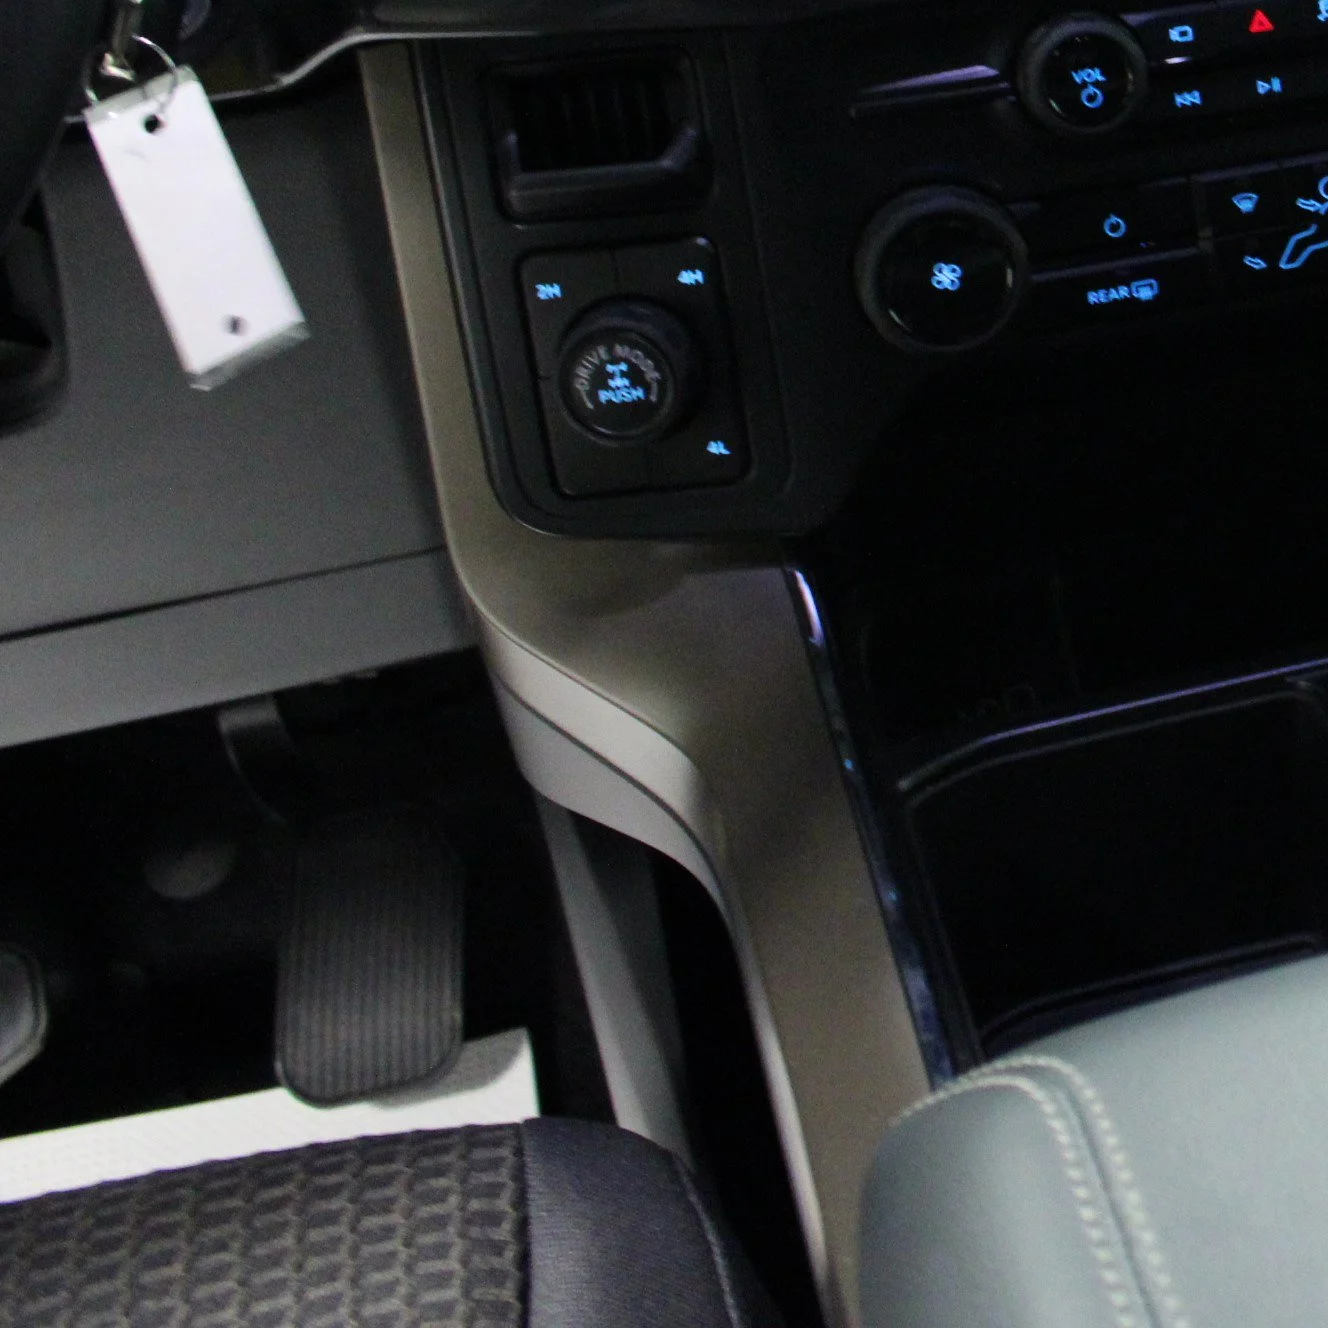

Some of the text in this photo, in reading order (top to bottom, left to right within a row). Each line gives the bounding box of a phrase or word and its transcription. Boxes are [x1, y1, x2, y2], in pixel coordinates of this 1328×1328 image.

[1071, 66, 1107, 85] VOL
[677, 269, 705, 286] 4H
[535, 283, 563, 301] 2H
[1087, 285, 1131, 305] REAR
[597, 386, 646, 404] PUSH
[706, 439, 732, 455] 4L
